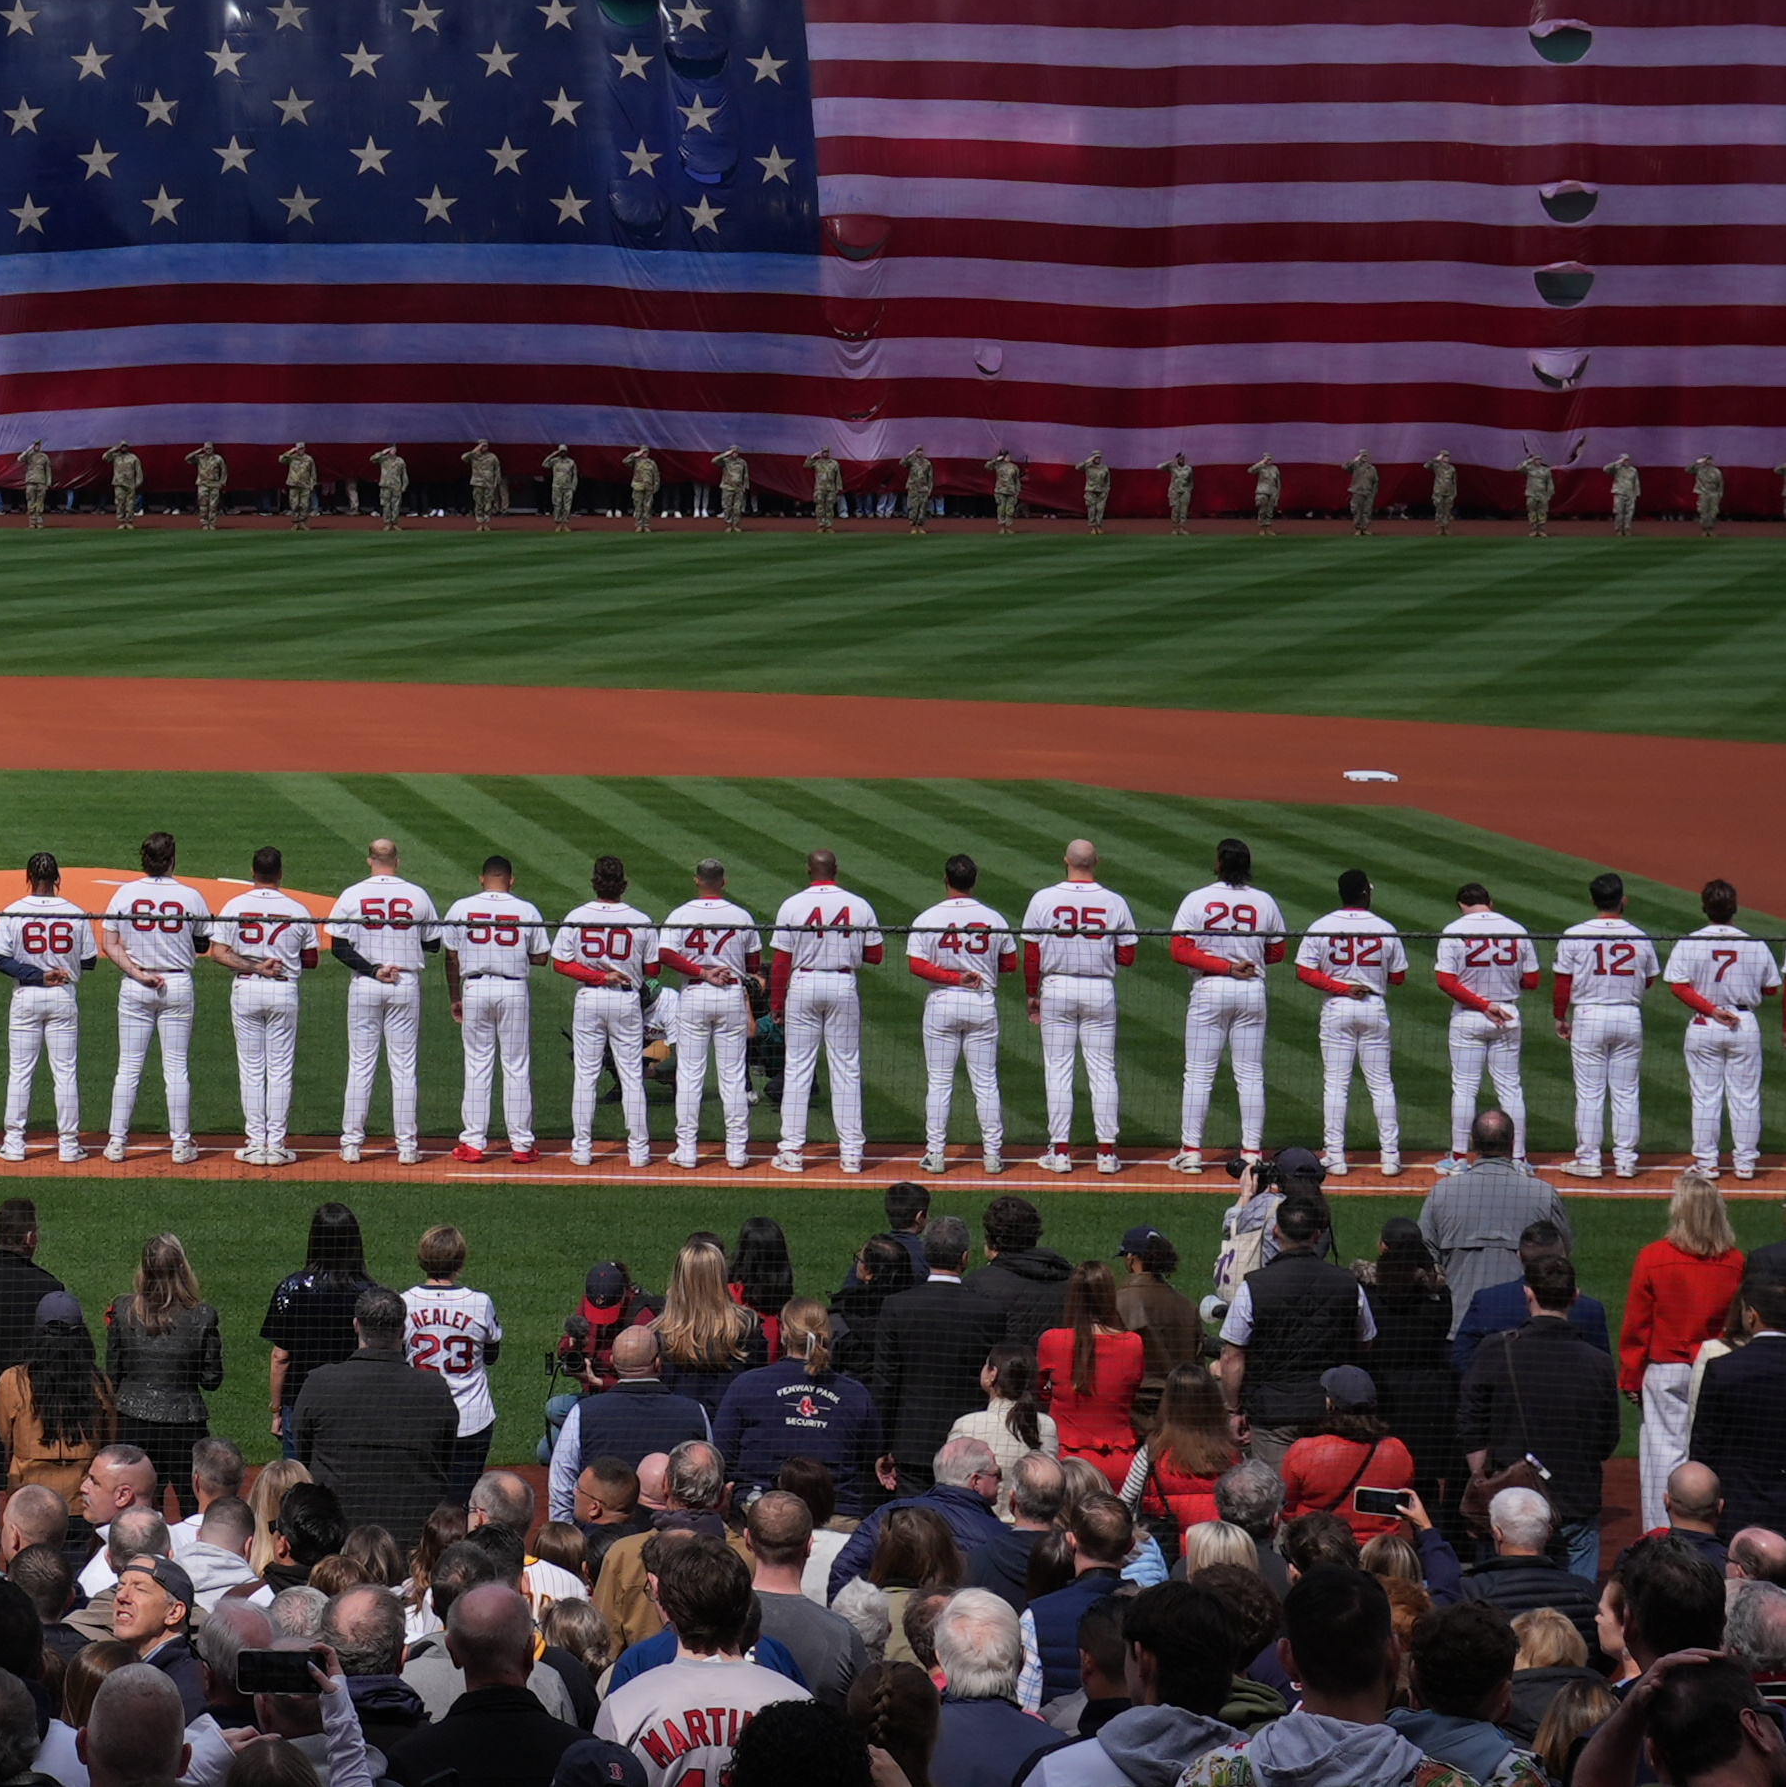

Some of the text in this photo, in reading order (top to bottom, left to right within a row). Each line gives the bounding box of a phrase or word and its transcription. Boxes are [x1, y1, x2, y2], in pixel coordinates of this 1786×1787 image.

[238, 911, 290, 946] 57
[359, 897, 414, 930] 56
[466, 912, 520, 946] 55
[803, 906, 852, 939] 44
[1051, 905, 1108, 939] 35
[1203, 901, 1259, 932] 29
[21, 921, 74, 955] 66
[580, 926, 633, 960] 50
[683, 925, 735, 956] 47
[937, 923, 989, 956] 43
[1328, 935, 1383, 968] 32
[1464, 937, 1518, 968] 23
[1592, 943, 1636, 976] 12
[1711, 949, 1738, 984] 7
[410, 1308, 473, 1331] HEALEY
[410, 1334, 474, 1374] 23
[777, 1384, 840, 1404] FENWAY PARK
[785, 1417, 828, 1429] SECURITY
[639, 1707, 754, 1769] MARTI
